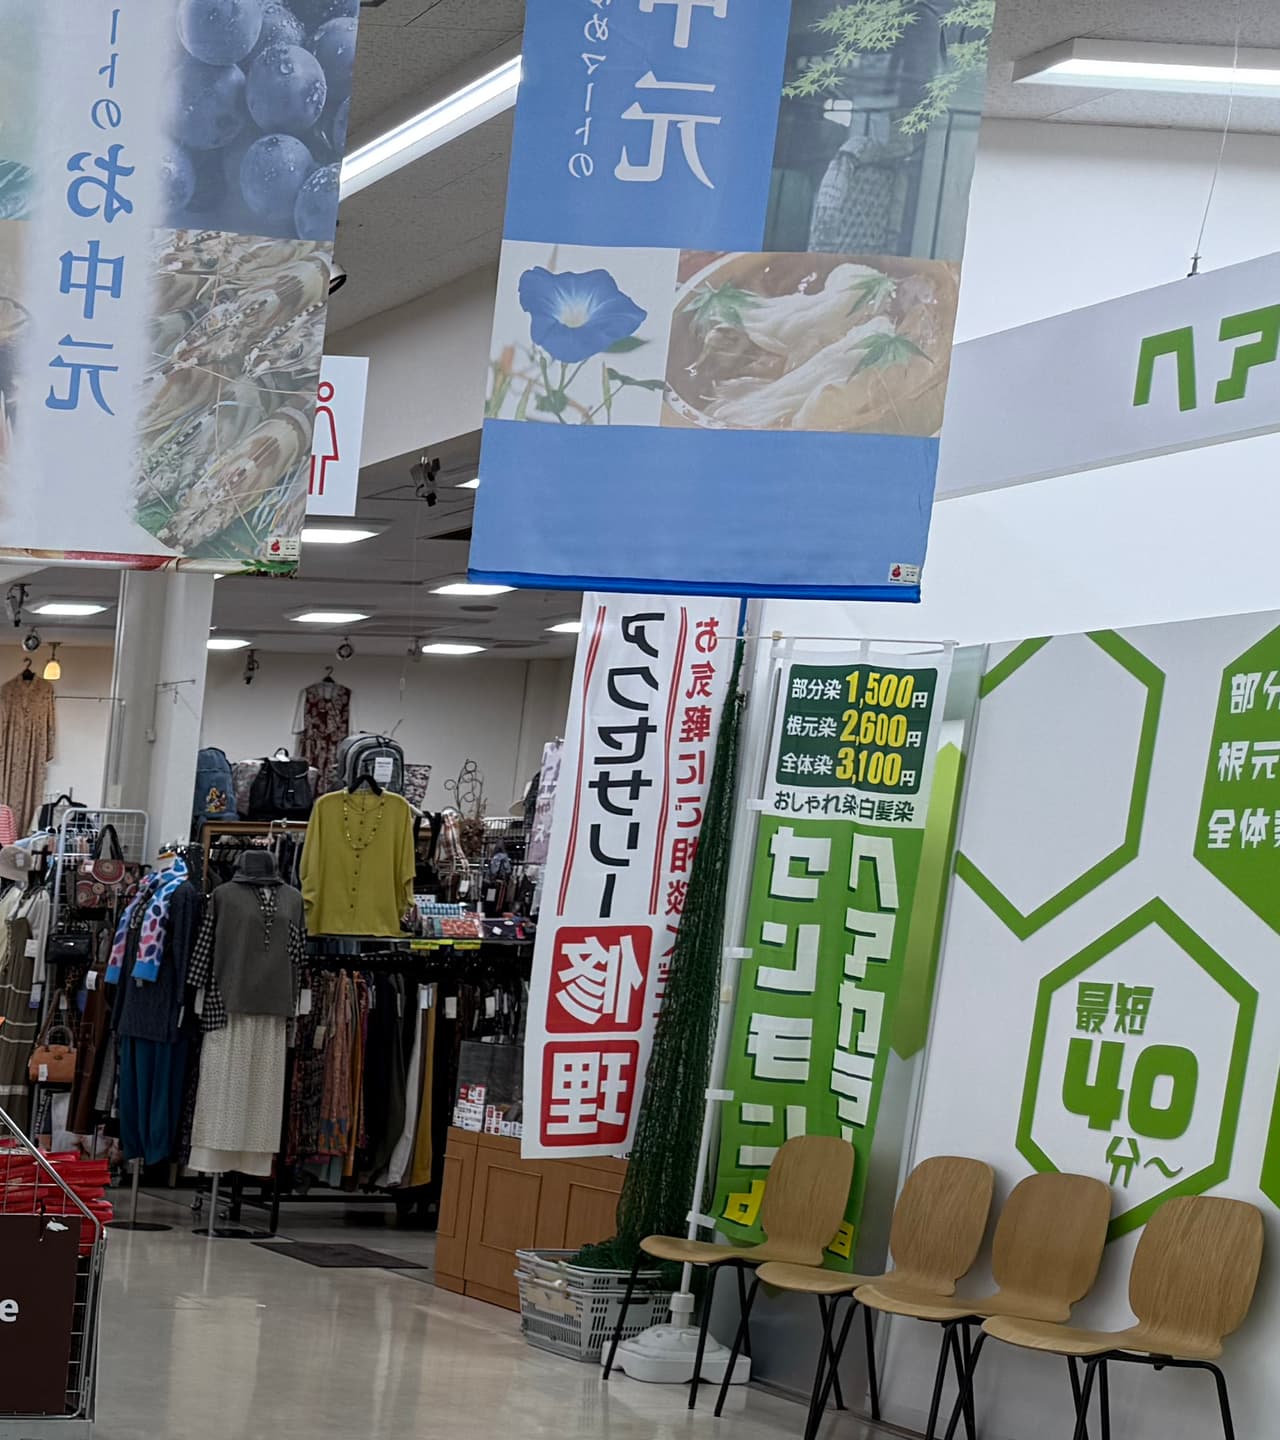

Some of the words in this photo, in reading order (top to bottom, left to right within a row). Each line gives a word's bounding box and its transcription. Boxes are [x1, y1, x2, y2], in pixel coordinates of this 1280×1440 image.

[792, 677, 842, 701] 部分染
[786, 715, 837, 738] 根元染
[781, 752, 833, 776] 全体染
[1076, 981, 1154, 1036] 最短
[1061, 1036, 1199, 1140] 40
